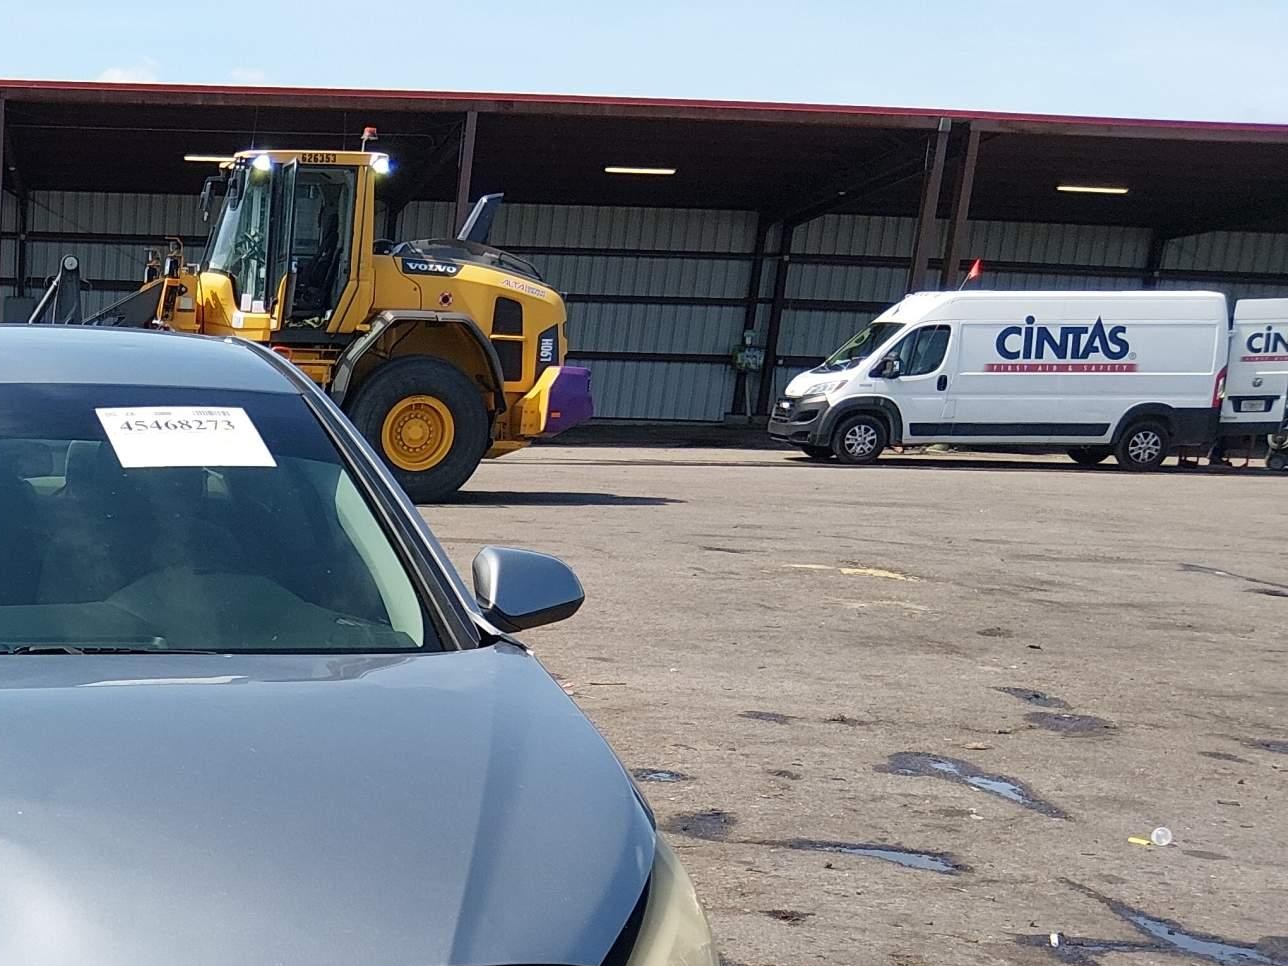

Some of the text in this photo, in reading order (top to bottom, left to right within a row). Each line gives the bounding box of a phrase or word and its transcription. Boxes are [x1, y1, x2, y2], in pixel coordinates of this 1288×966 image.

[405, 262, 457, 273] VOLVO
[540, 338, 554, 362] L90H
[120, 419, 235, 431] 45468273
